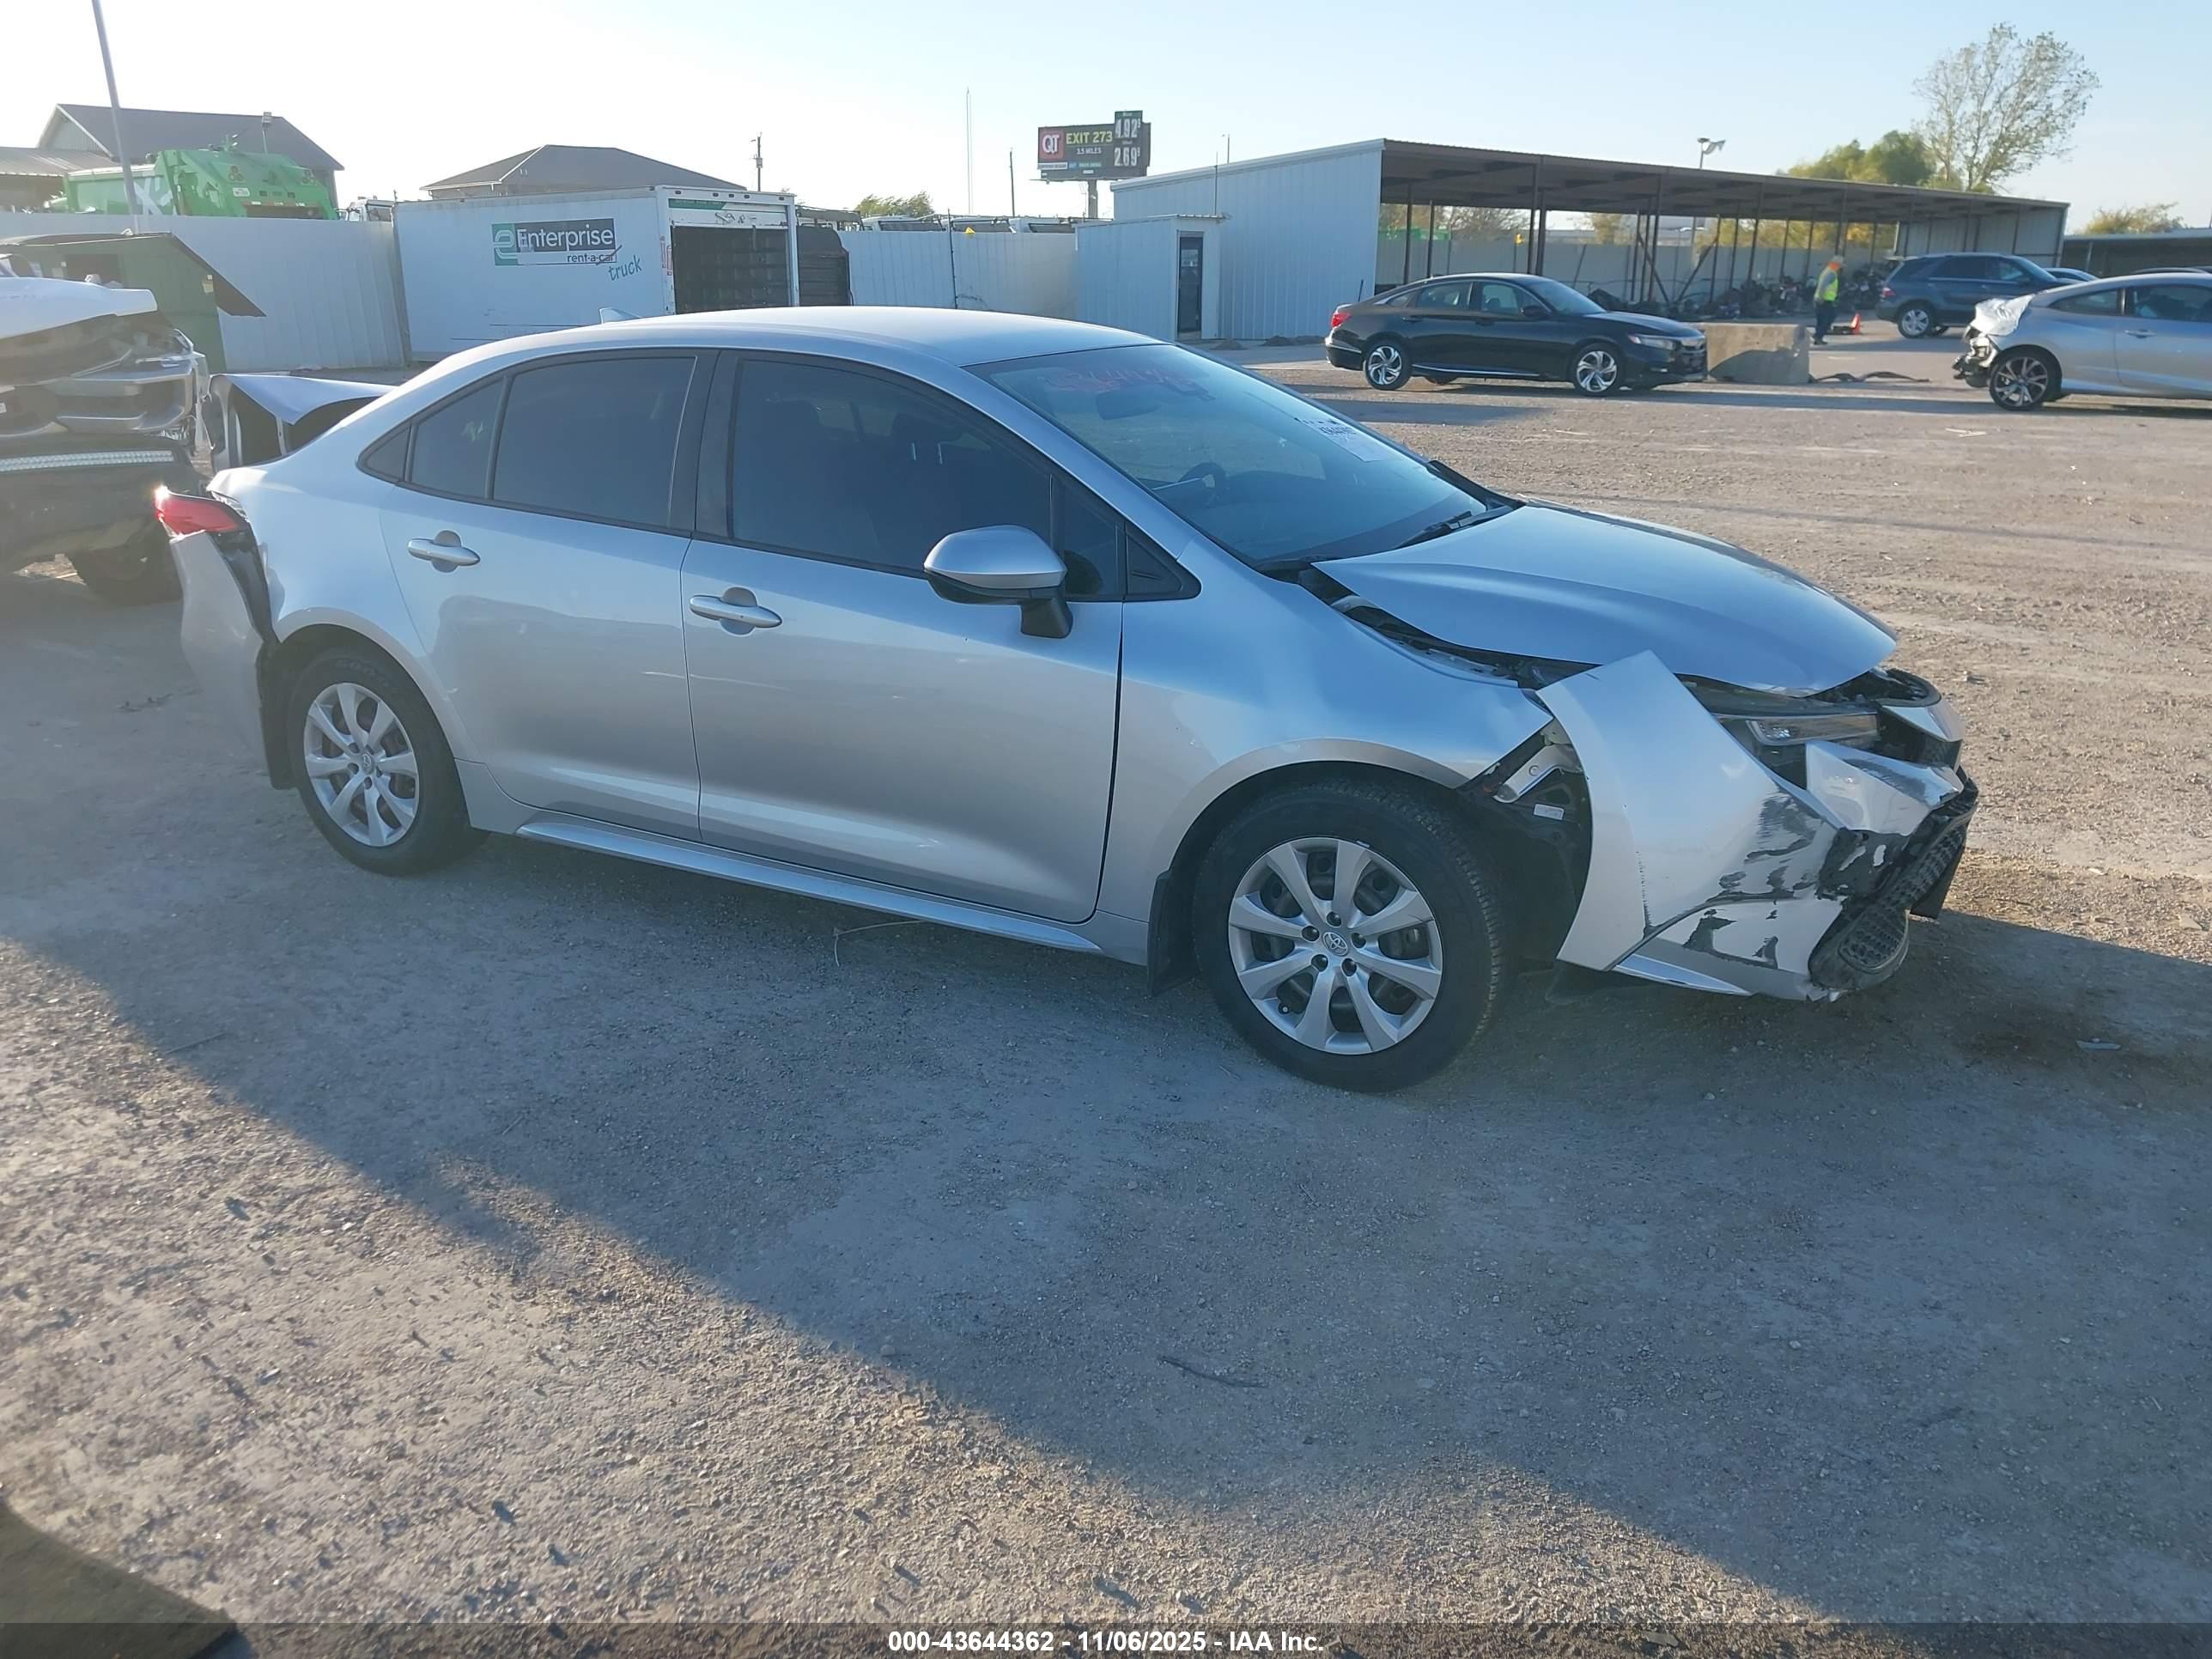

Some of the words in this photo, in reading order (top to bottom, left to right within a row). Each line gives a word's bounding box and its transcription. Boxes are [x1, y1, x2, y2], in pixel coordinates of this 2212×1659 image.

[1042, 135, 1060, 154] QT
[1066, 132, 1090, 144] EXIT
[1092, 131, 1113, 143] 273
[1114, 147, 1137, 167] 2.69
[516, 224, 614, 251] Enterprise
[567, 253, 615, 264] rent-a-car
[608, 255, 642, 281] truck
